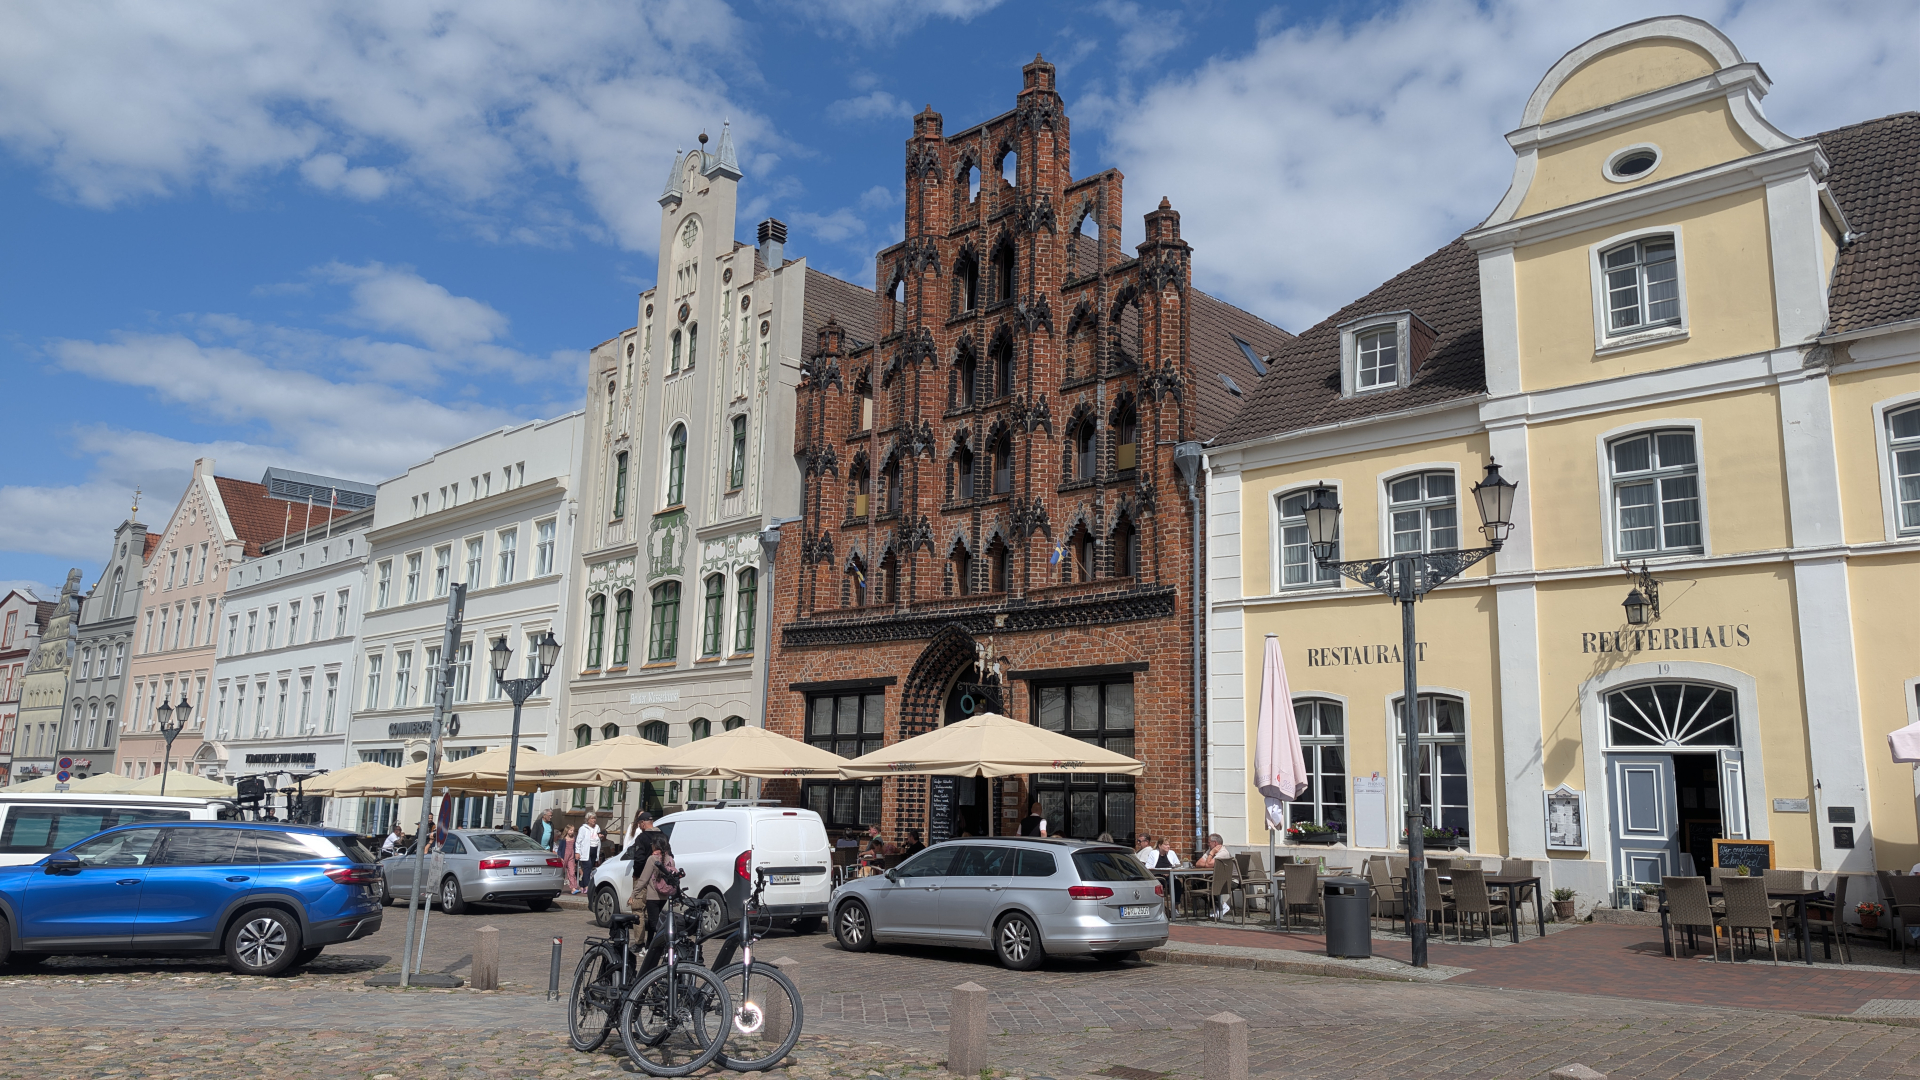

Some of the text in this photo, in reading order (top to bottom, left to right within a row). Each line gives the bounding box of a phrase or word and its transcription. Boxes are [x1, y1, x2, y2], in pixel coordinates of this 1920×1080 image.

[1582, 624, 1751, 653] REUTERHAUS
[1307, 642, 1428, 667] RESTAURAT
[1657, 664, 1670, 675] 19
[388, 721, 433, 736] COMMERZB
